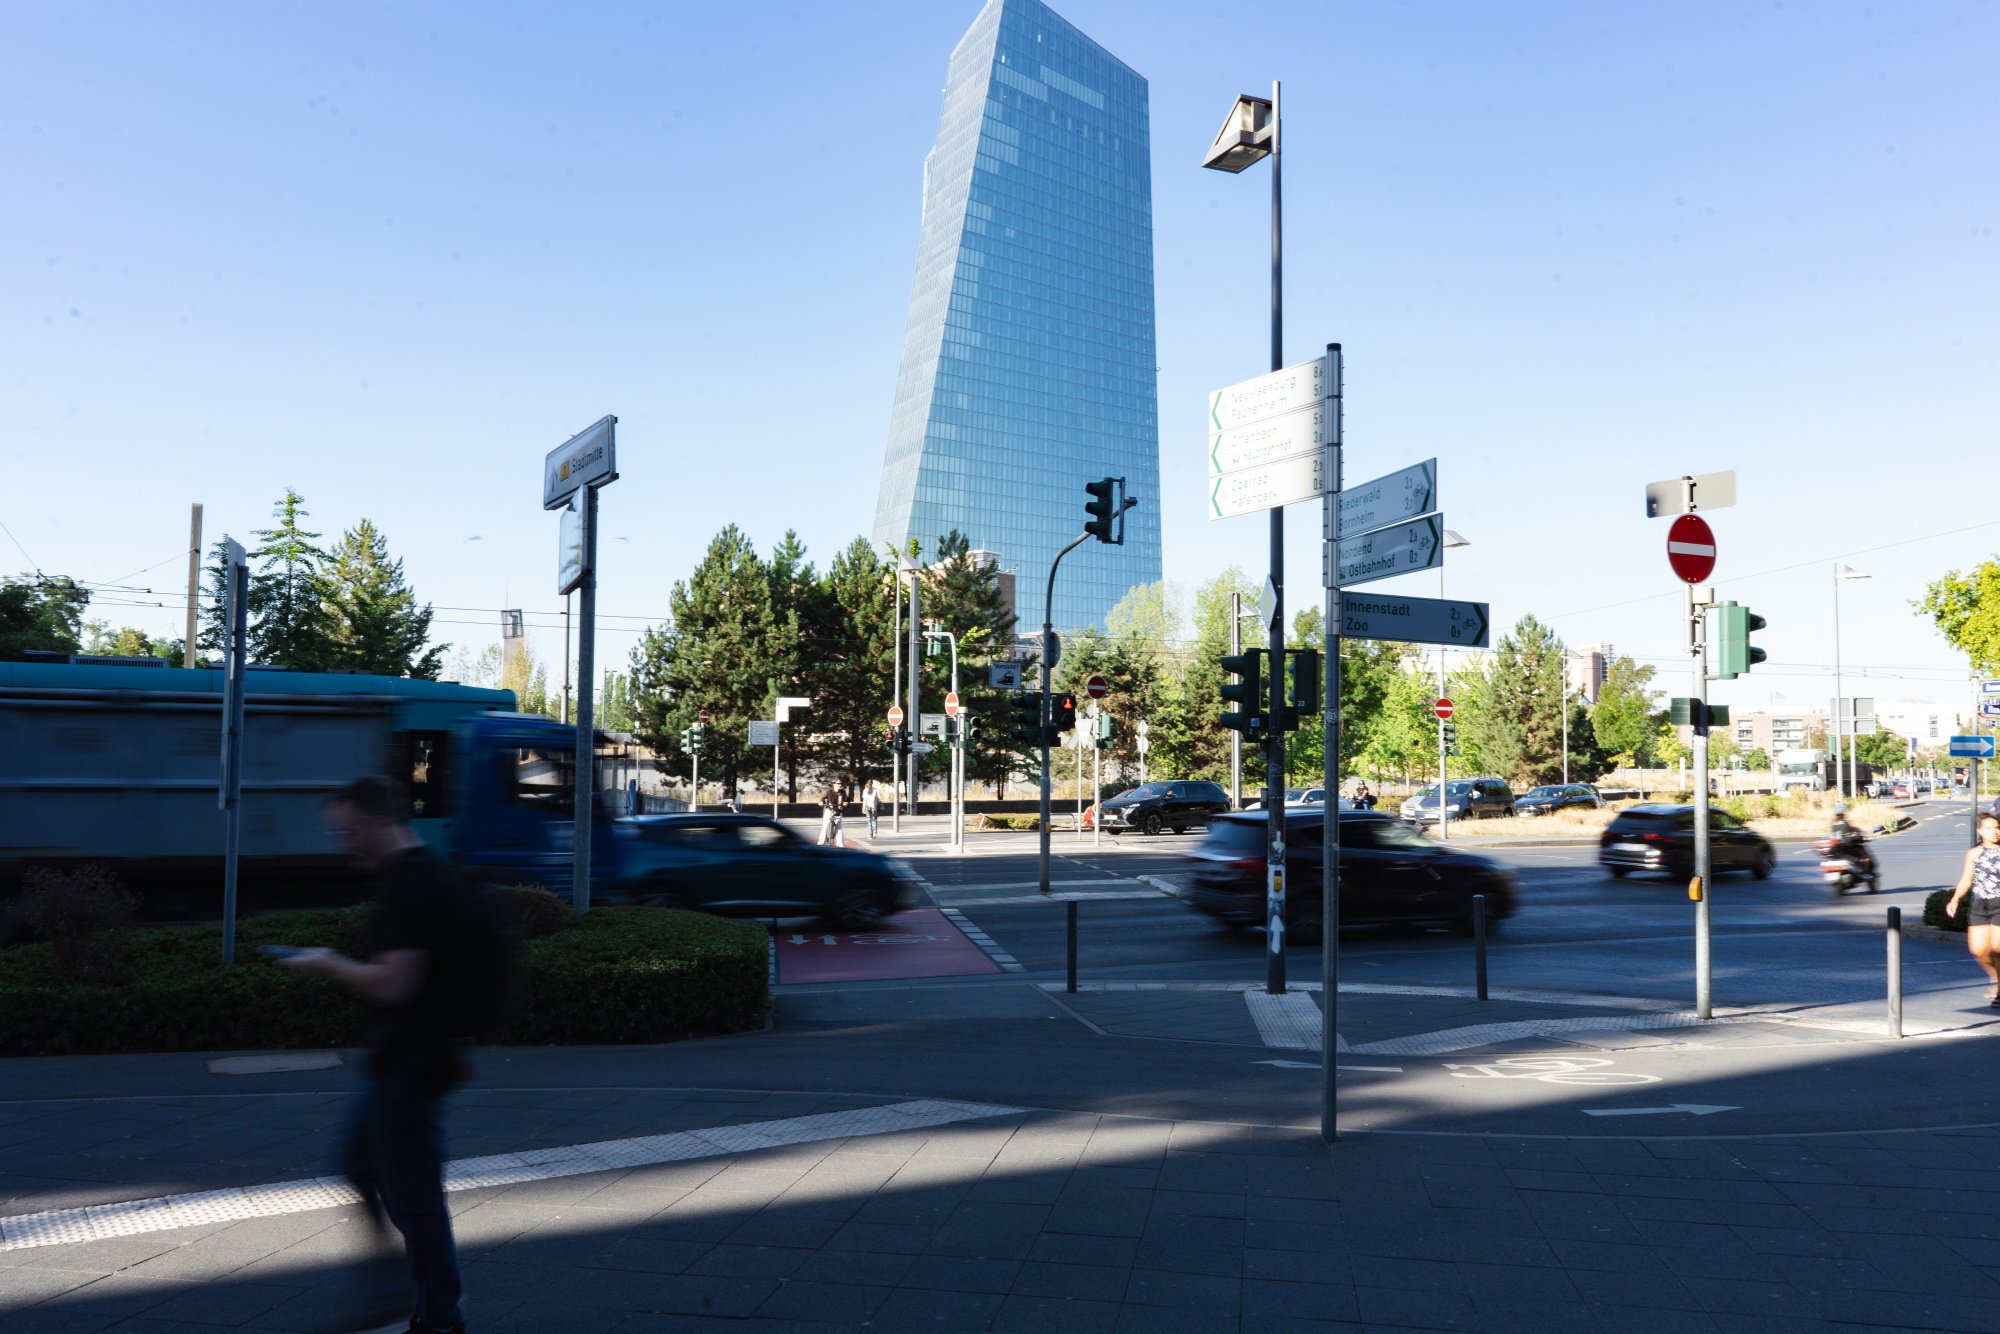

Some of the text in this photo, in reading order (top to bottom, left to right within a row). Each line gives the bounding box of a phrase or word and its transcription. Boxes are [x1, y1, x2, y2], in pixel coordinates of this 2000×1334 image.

[572, 445, 603, 473] Stadtmitte
[1339, 486, 1381, 512] Riederwald
[1339, 510, 1375, 531] Bornheim
[1339, 540, 1372, 561] Nordend
[1349, 554, 1396, 577] Ostbahnhof
[1346, 599, 1410, 616] Innenstadt
[1346, 617, 1369, 631] Zoo
